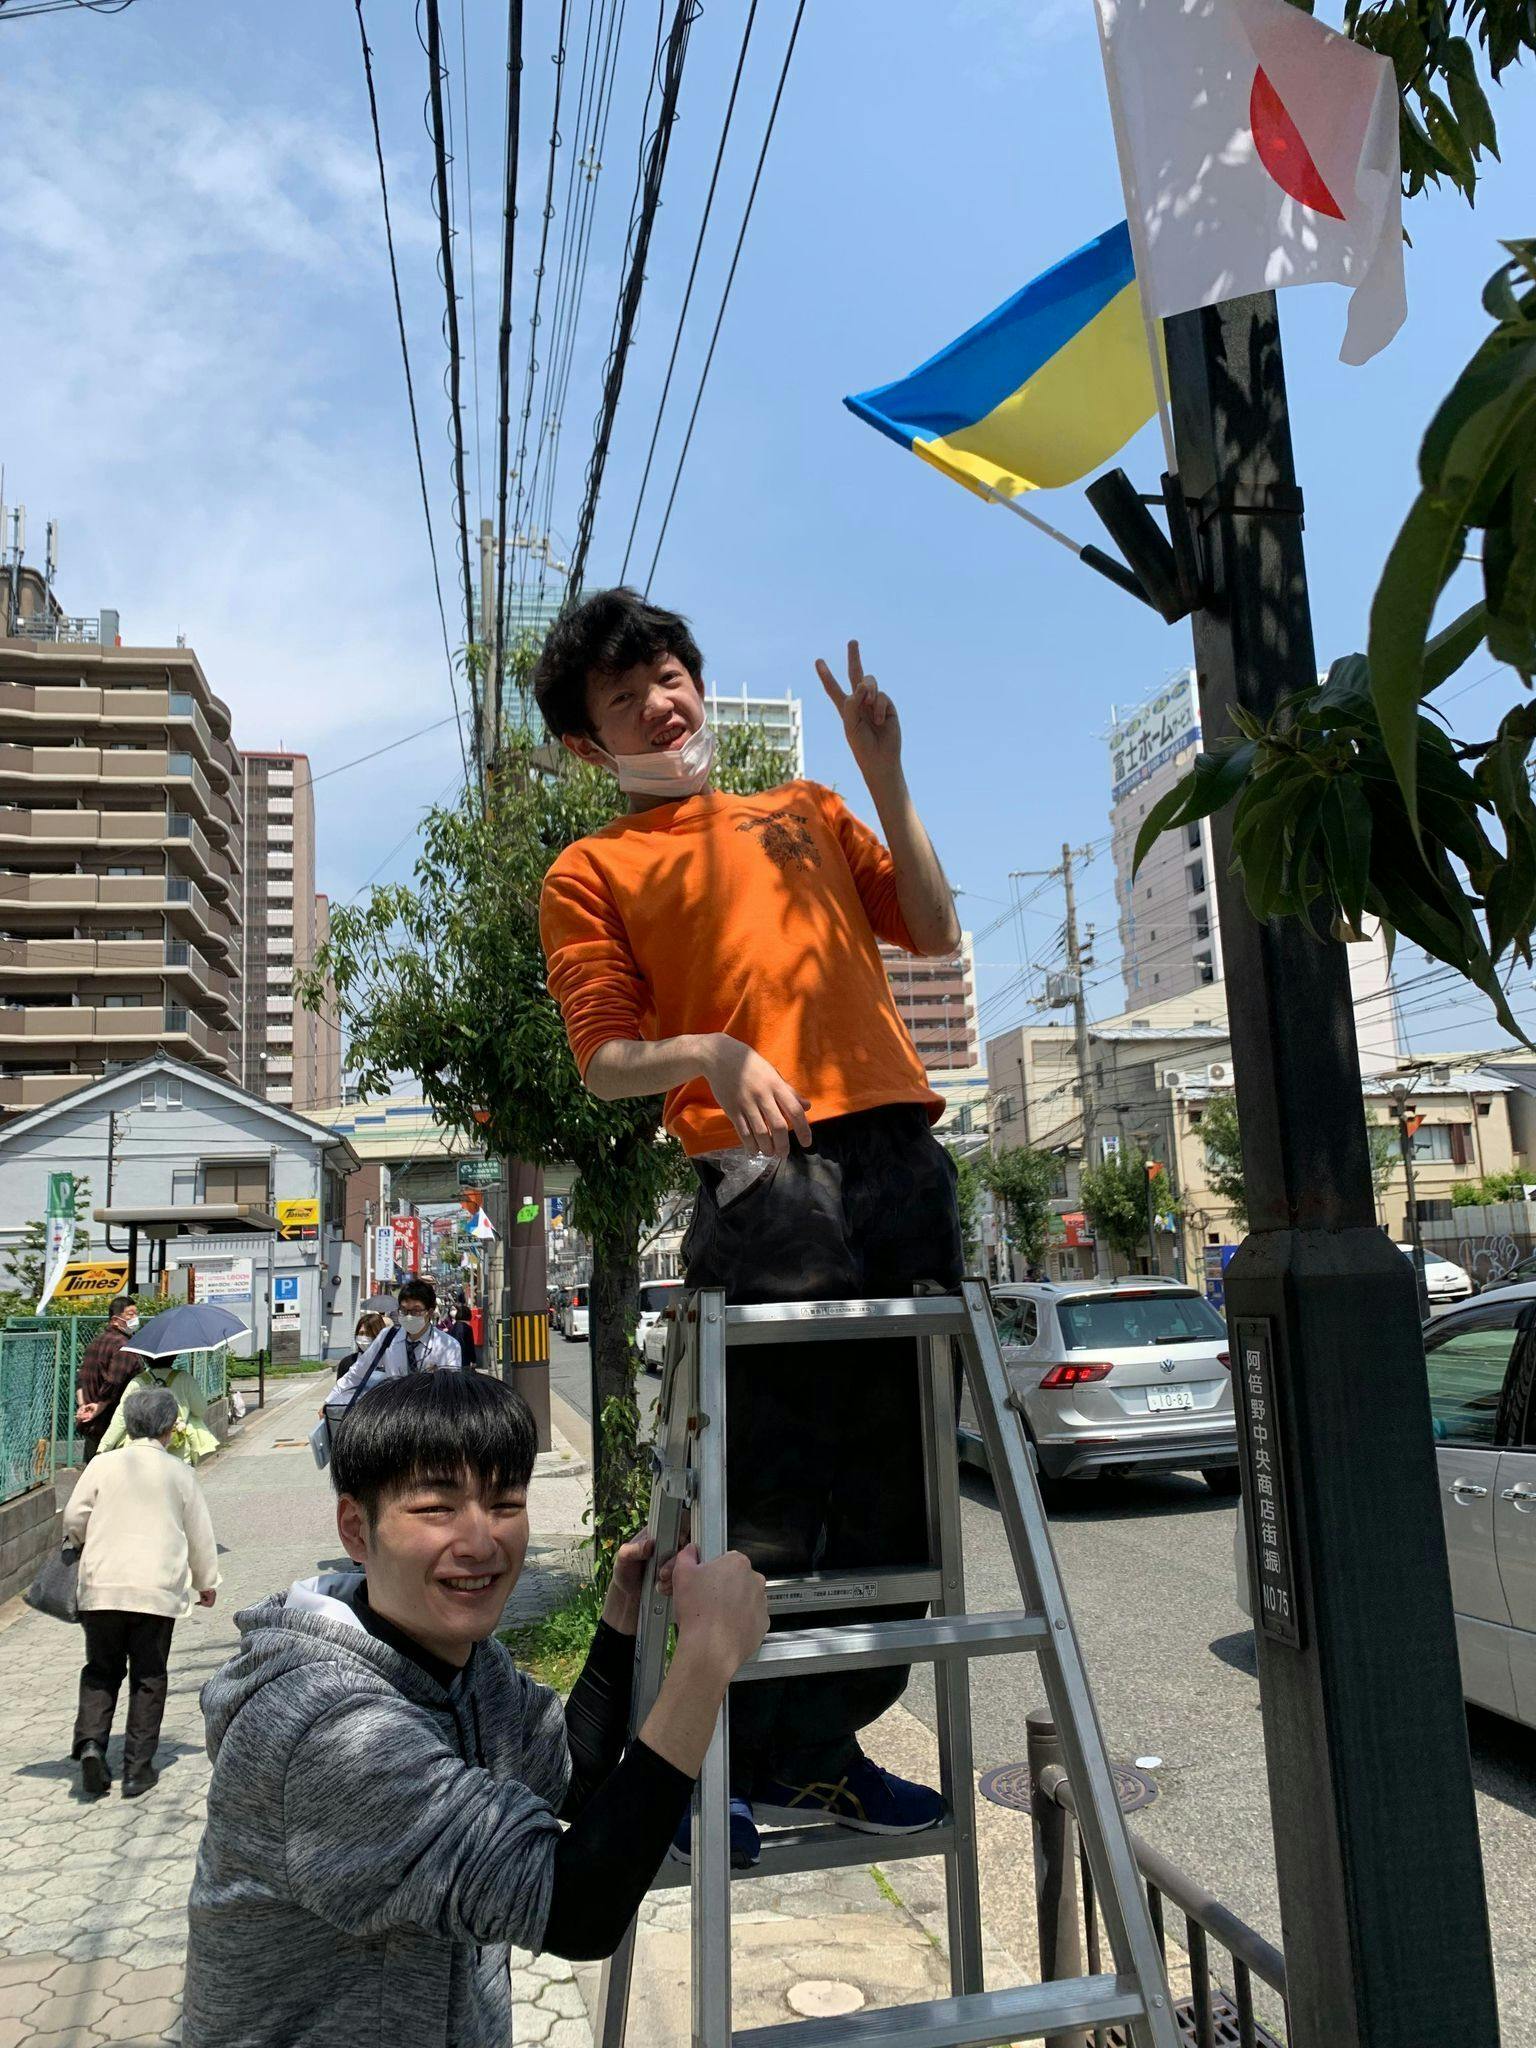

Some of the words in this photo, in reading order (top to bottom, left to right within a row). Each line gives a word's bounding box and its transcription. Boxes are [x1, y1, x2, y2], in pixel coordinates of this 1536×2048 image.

[64, 1275, 120, 1292] Times
[281, 1279, 293, 1294] P
[1246, 1350, 1281, 1574] 阿倍野中央商店街振
